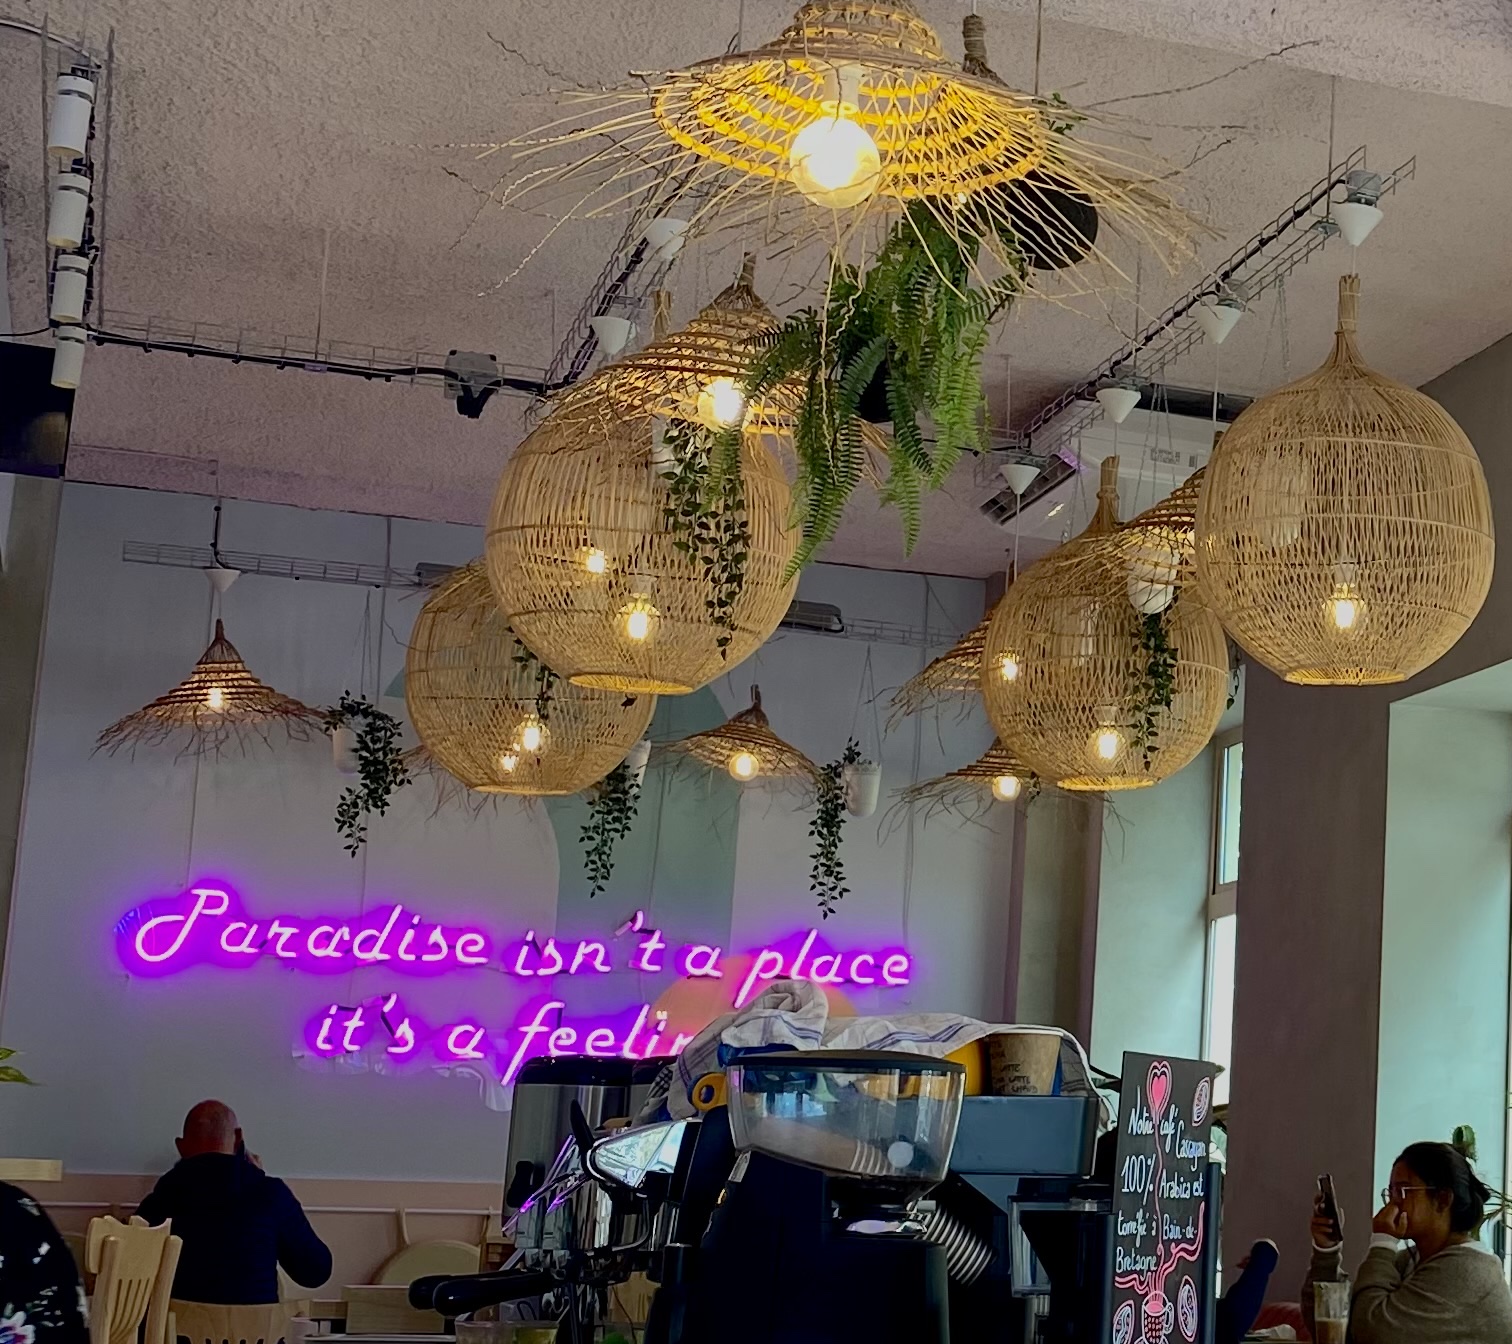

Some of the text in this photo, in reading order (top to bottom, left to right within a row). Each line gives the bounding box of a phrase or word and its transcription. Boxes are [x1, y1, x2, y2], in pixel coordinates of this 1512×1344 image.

[134, 887, 912, 1007] Paradise isn't a place
[315, 992, 416, 1054] it's
[446, 1024, 486, 1059] a
[1127, 1085, 1179, 1154] Notre café
[1120, 1150, 1157, 1205] 100%
[1158, 1168, 1191, 1199] Arabica
[1116, 1246, 1158, 1278] Bretagne
